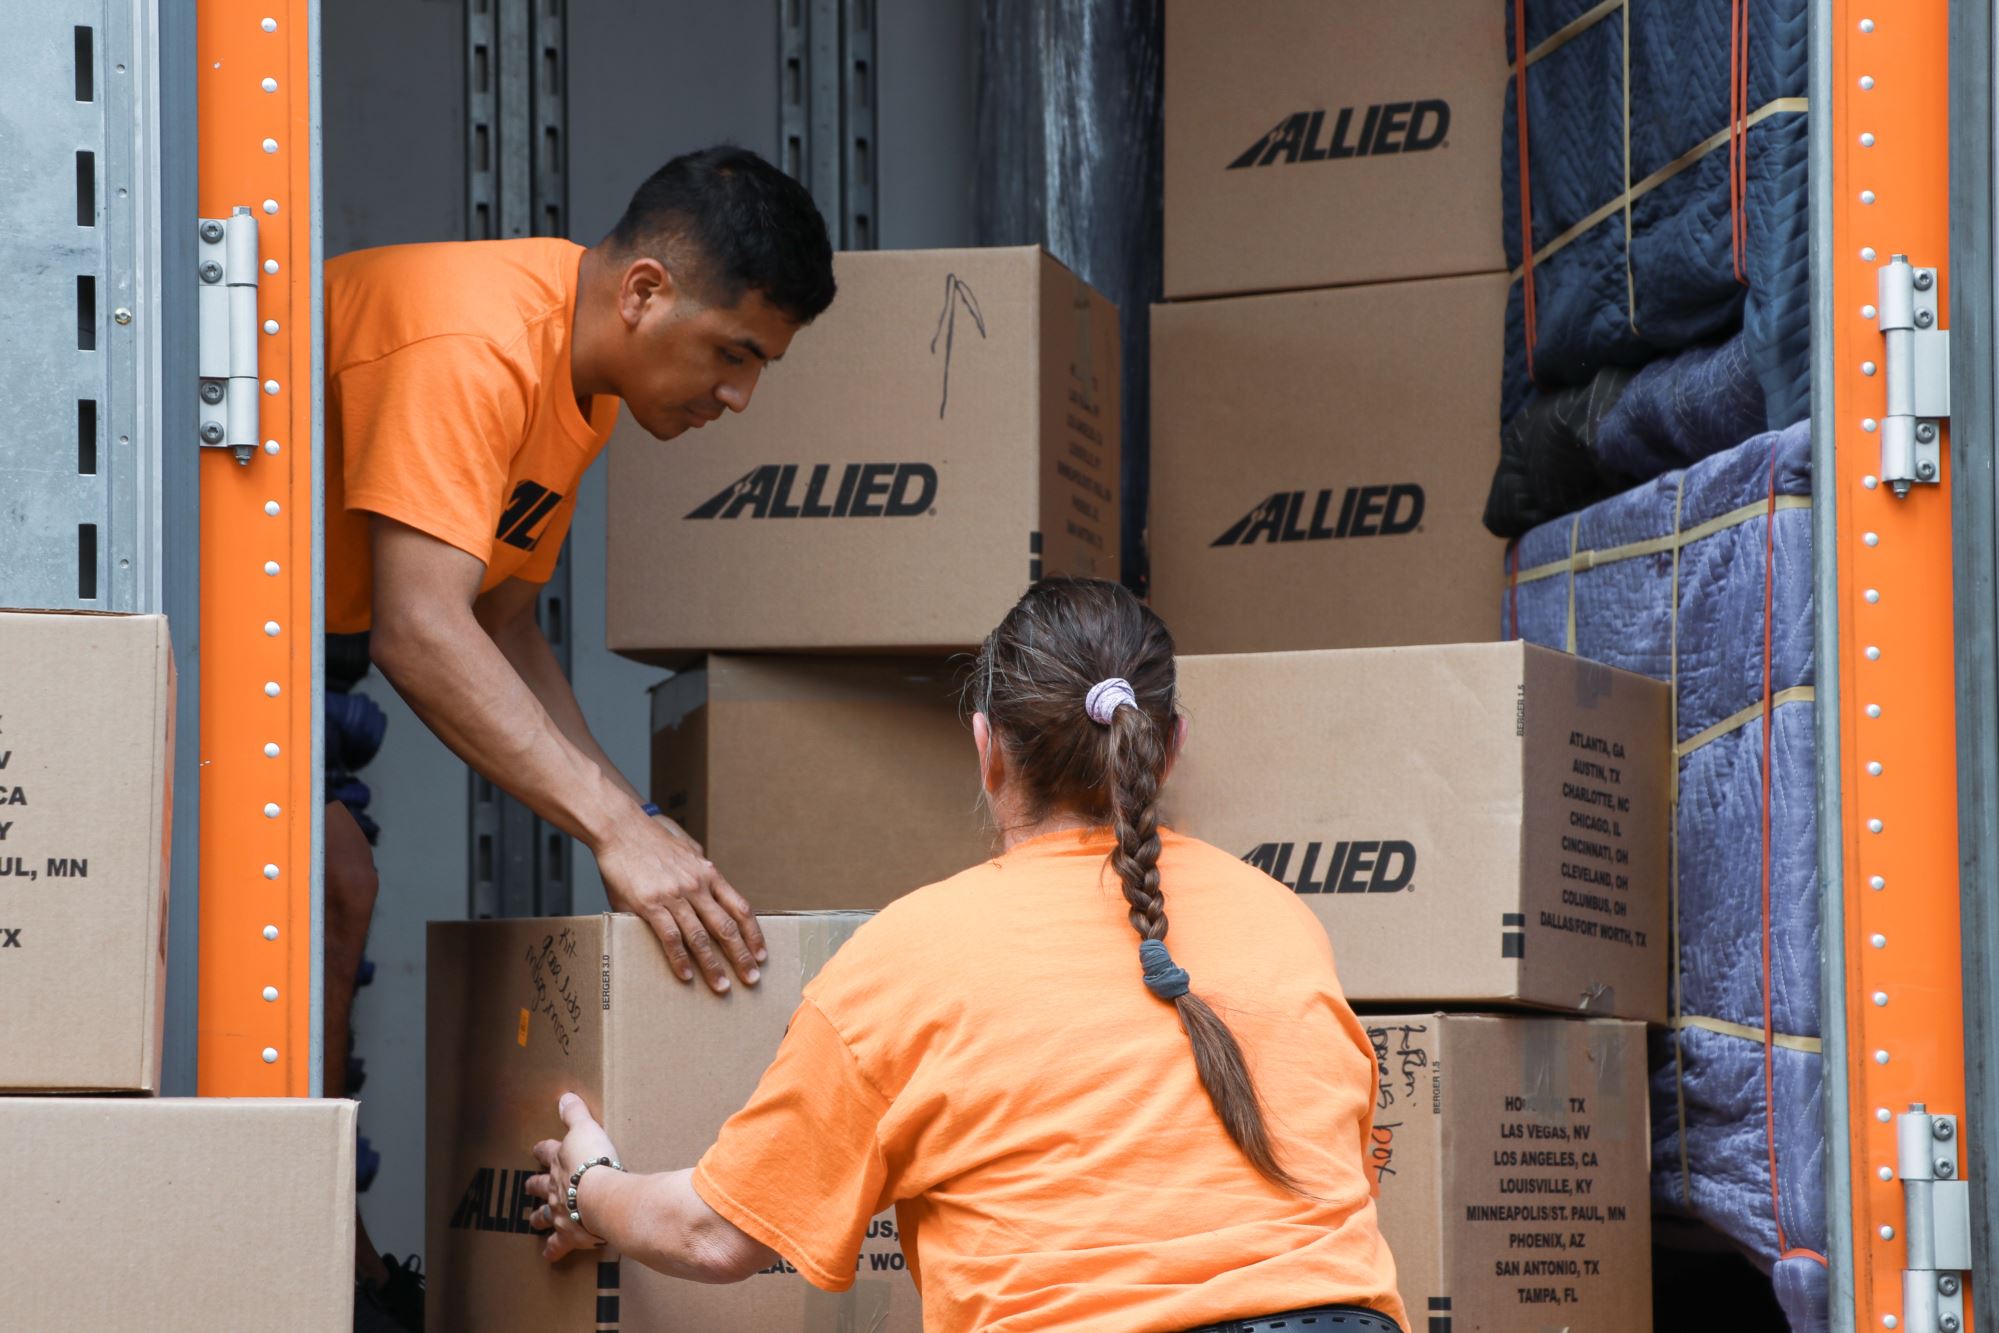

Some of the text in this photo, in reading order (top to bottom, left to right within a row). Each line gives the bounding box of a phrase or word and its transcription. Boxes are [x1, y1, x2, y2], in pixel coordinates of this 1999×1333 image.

[1226, 98, 1451, 170] ALLIED
[682, 462, 938, 519] ALLIED
[1209, 483, 1425, 548] ALLIED
[1569, 730, 1625, 758] ATLANTA, GA
[1572, 759, 1621, 784] AUSTIN, TX
[1562, 781, 1630, 812] CHARLOTTE, NC
[1569, 810, 1622, 837] CHICAGO, IL
[1561, 836, 1629, 864] CINCINNATI, OH
[46, 858, 88, 877] MN
[1561, 862, 1629, 890] CLEVELAND, OH
[1562, 889, 1627, 917] COLUMBUS, OH
[0, 928, 22, 948] X
[1600, 924, 1634, 947] WORTH,
[1634, 931, 1648, 948] TX
[602, 953, 610, 1010] BERGER 3.0
[1432, 1060, 1441, 1114] BERGER 1.5
[1569, 1098, 1586, 1113] TX
[1501, 1123, 1591, 1142] LAS VEGAS, NV
[1371, 1121, 1404, 1184] box
[1494, 1151, 1599, 1169] LOS ANGELES, CA
[1500, 1178, 1593, 1196] LOUISVILLE, KY
[449, 1167, 545, 1236] ALLIE
[1571, 1206, 1605, 1224] PAUL,
[1607, 1206, 1627, 1222] MN
[1509, 1233, 1586, 1250] PHOENIX, AZ
[1495, 1260, 1600, 1277] SAN ANTONIO, TX
[1517, 1287, 1578, 1305] TAMPA, FL
